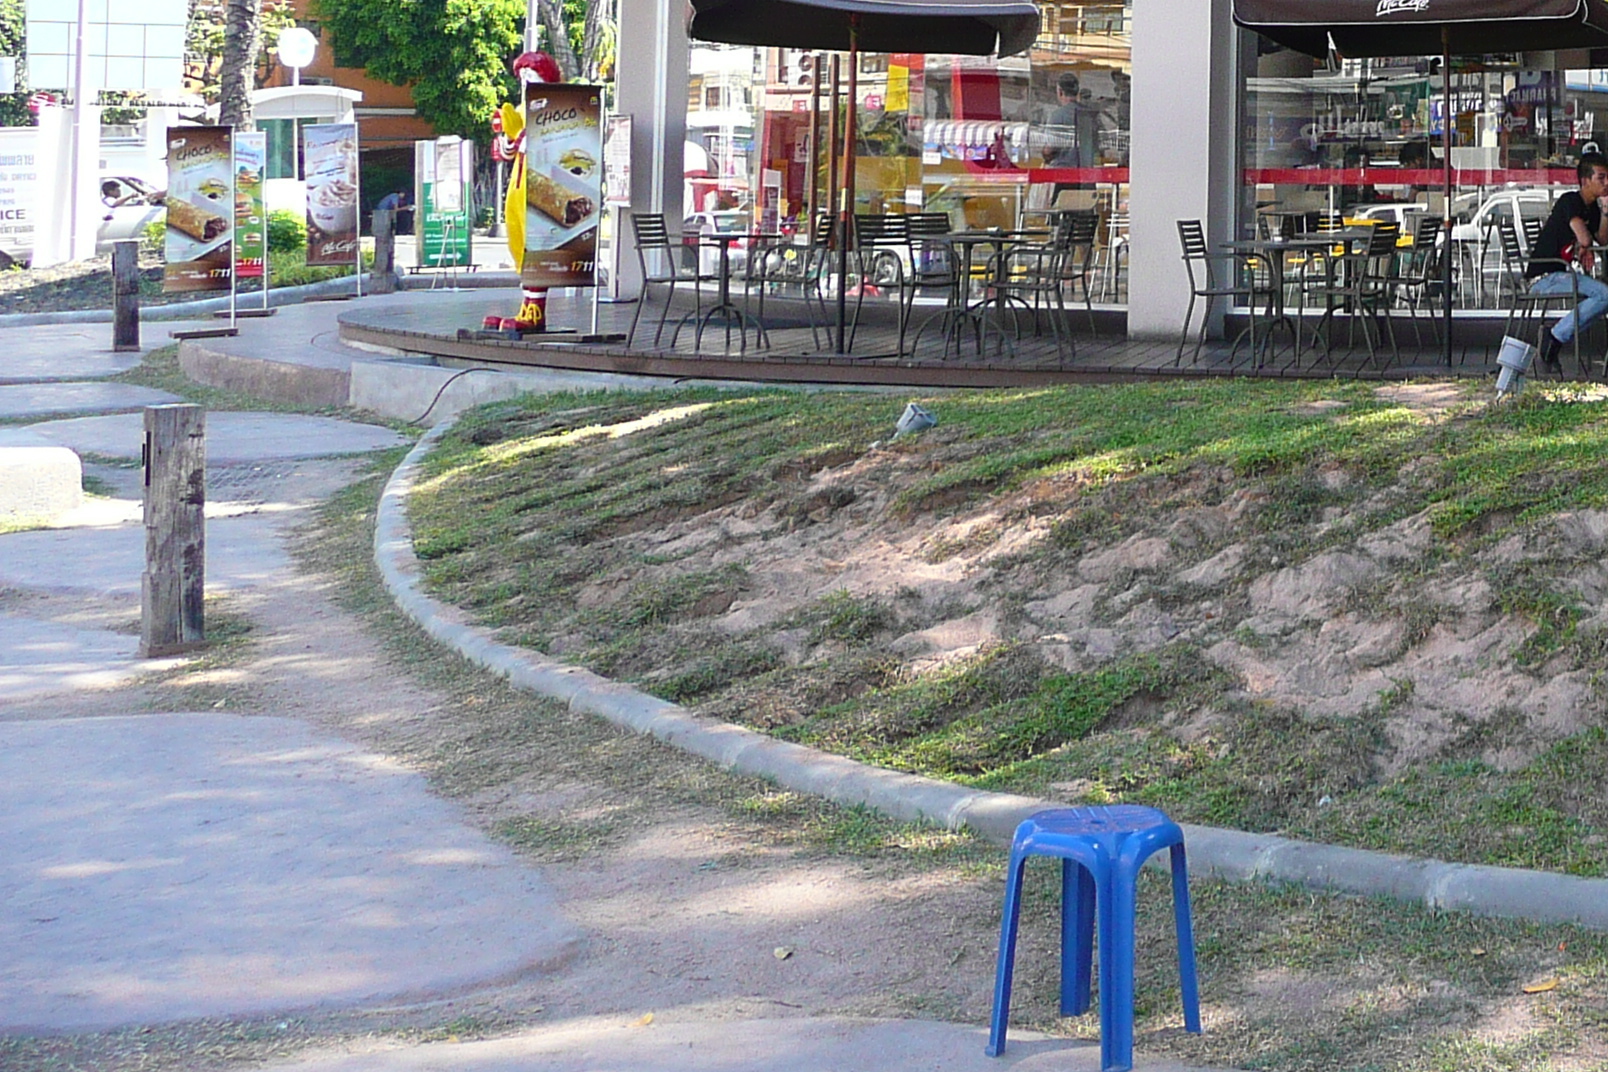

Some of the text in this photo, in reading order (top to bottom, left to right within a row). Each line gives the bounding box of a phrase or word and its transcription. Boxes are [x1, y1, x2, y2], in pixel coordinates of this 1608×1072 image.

[535, 107, 577, 127] CHOCO
[176, 144, 212, 161] CHOCO
[571, 260, 594, 272] 1711
[209, 268, 231, 279] 1711
